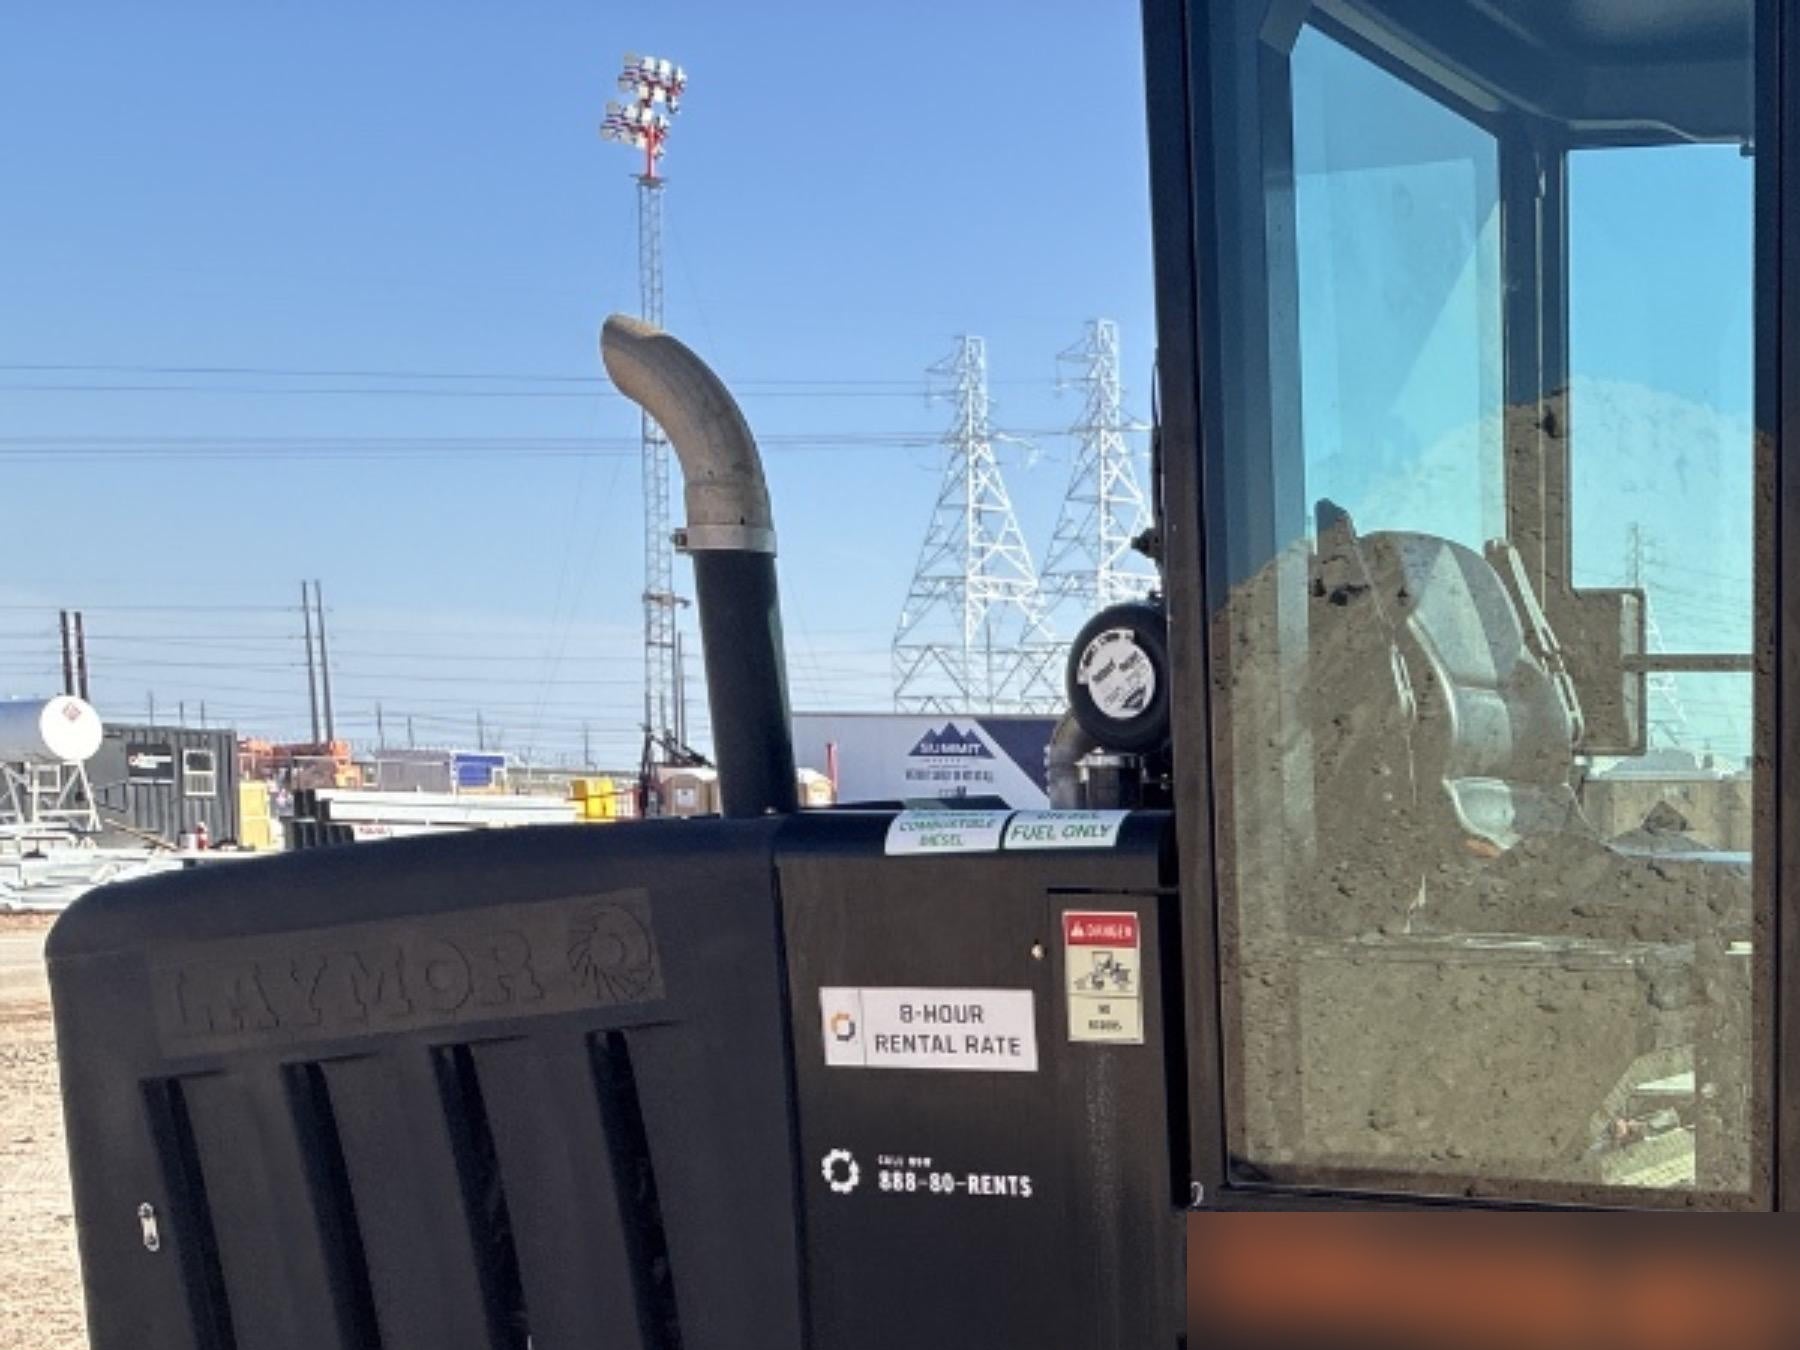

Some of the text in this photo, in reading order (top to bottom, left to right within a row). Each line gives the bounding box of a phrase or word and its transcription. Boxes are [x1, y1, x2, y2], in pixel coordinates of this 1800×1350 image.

[1010, 823, 1113, 841] FUEL ONLY
[898, 1003, 985, 1025] 8-HOUR
[874, 1033, 1022, 1057] RENTAL RATE
